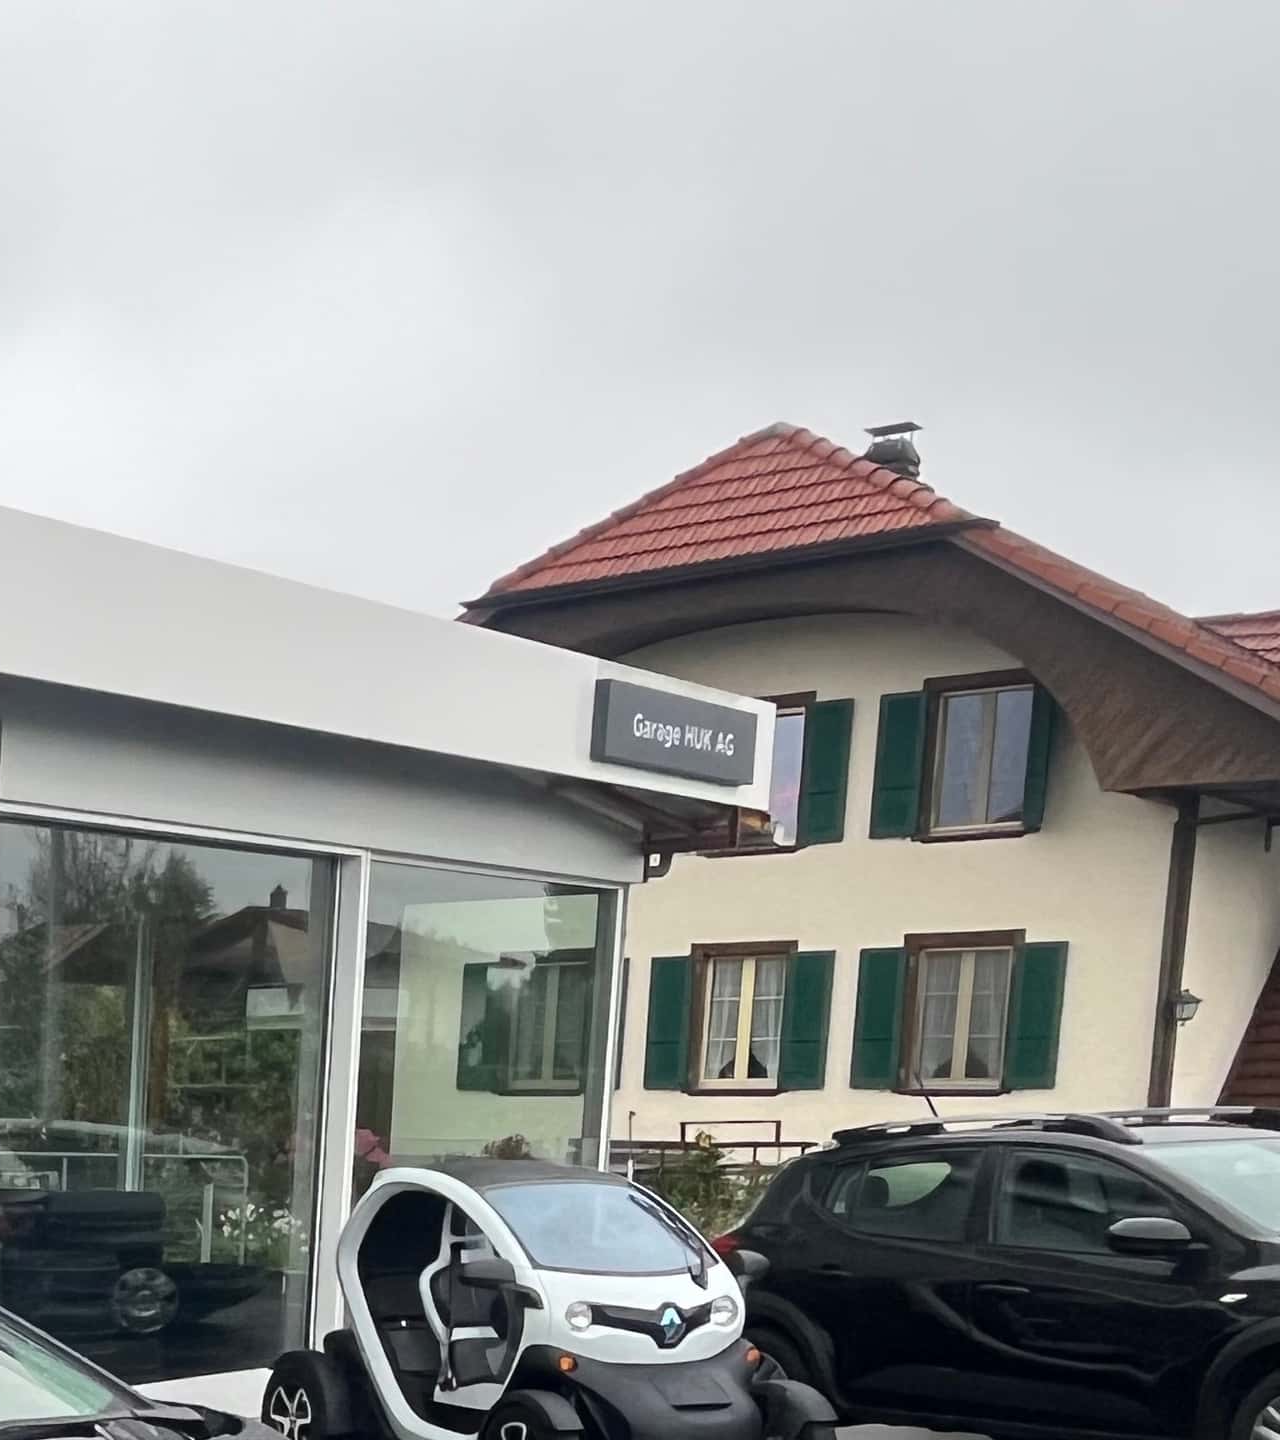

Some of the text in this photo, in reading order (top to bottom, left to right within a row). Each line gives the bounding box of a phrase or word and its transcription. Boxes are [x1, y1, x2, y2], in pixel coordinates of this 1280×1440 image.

[633, 713, 735, 756] Garage HUK AG
